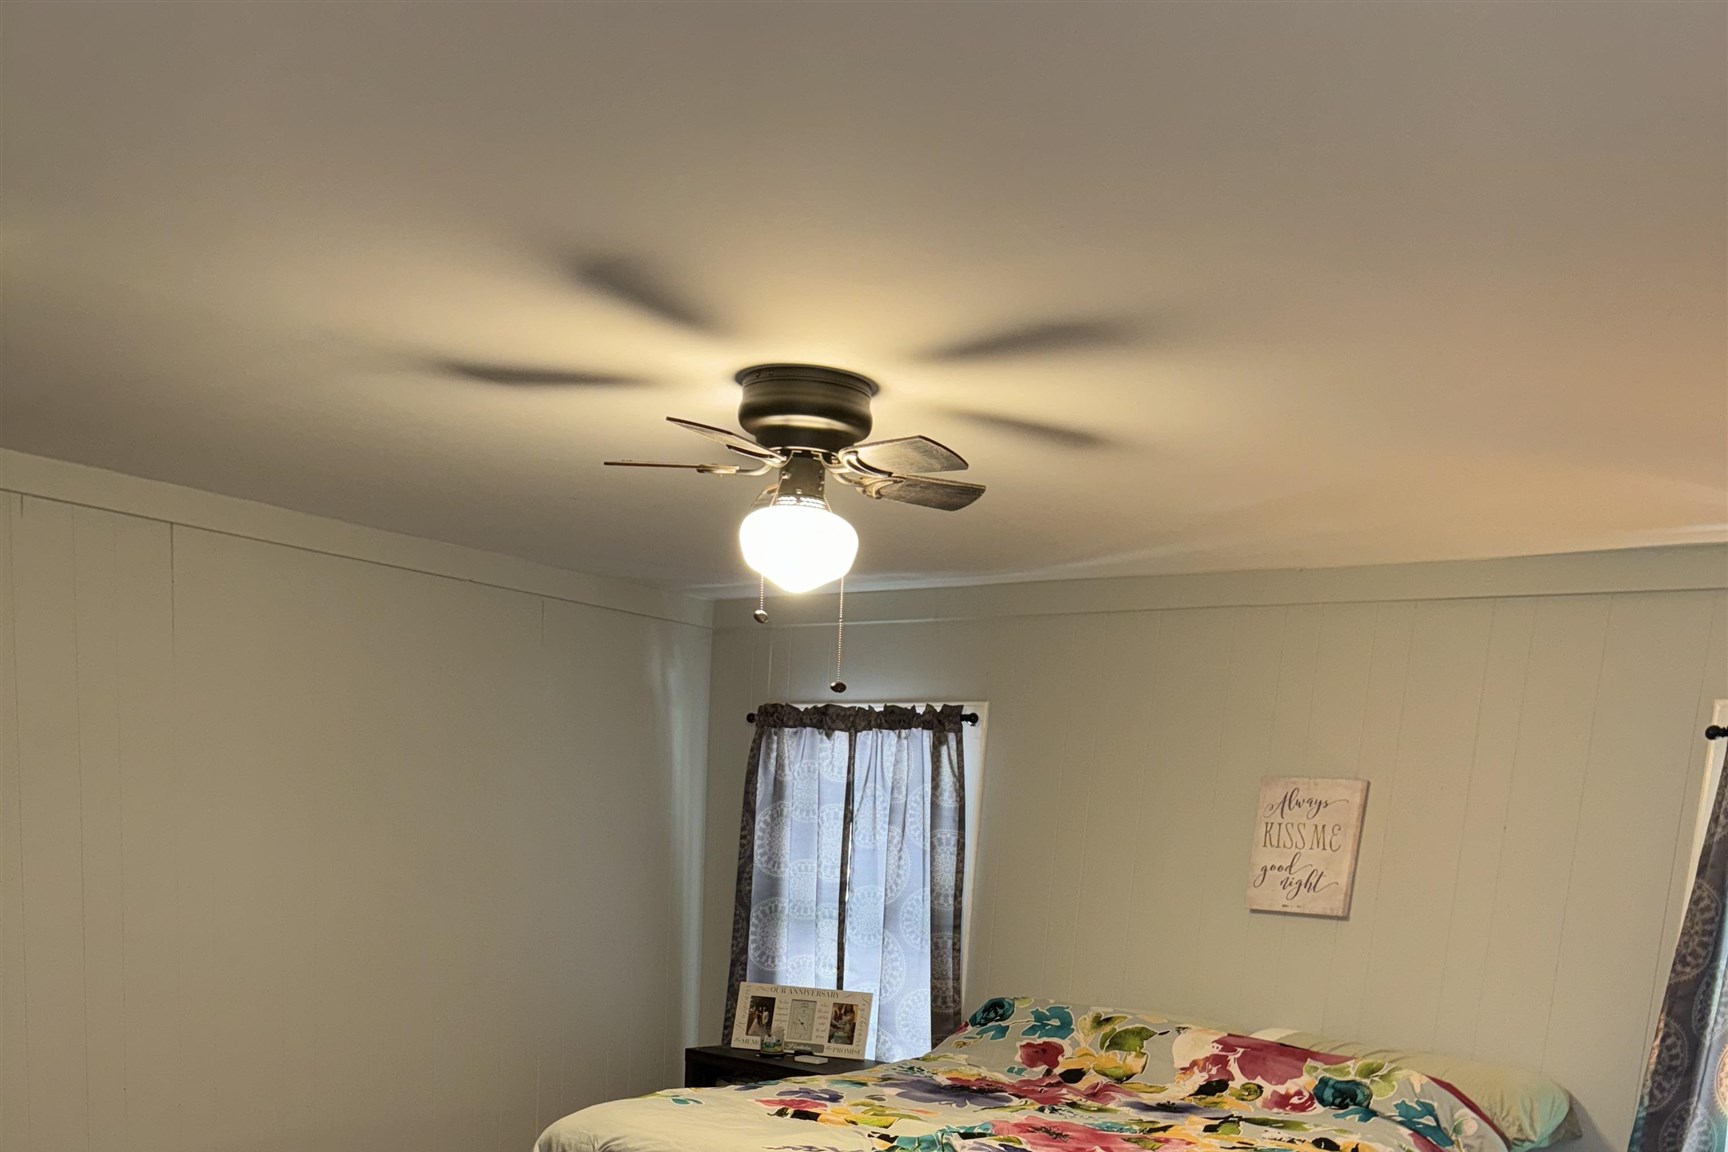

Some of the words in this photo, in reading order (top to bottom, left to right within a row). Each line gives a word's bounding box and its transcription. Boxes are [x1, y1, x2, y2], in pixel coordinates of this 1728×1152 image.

[1263, 787, 1349, 820] Always
[1262, 821, 1306, 850] KISS
[1309, 823, 1341, 852] ME
[1253, 851, 1312, 888] good
[1280, 868, 1339, 901] night
[770, 987, 786, 995] OUR
[789, 988, 840, 999] ANNIVERSARY
[833, 1047, 861, 1056] PROMISE
